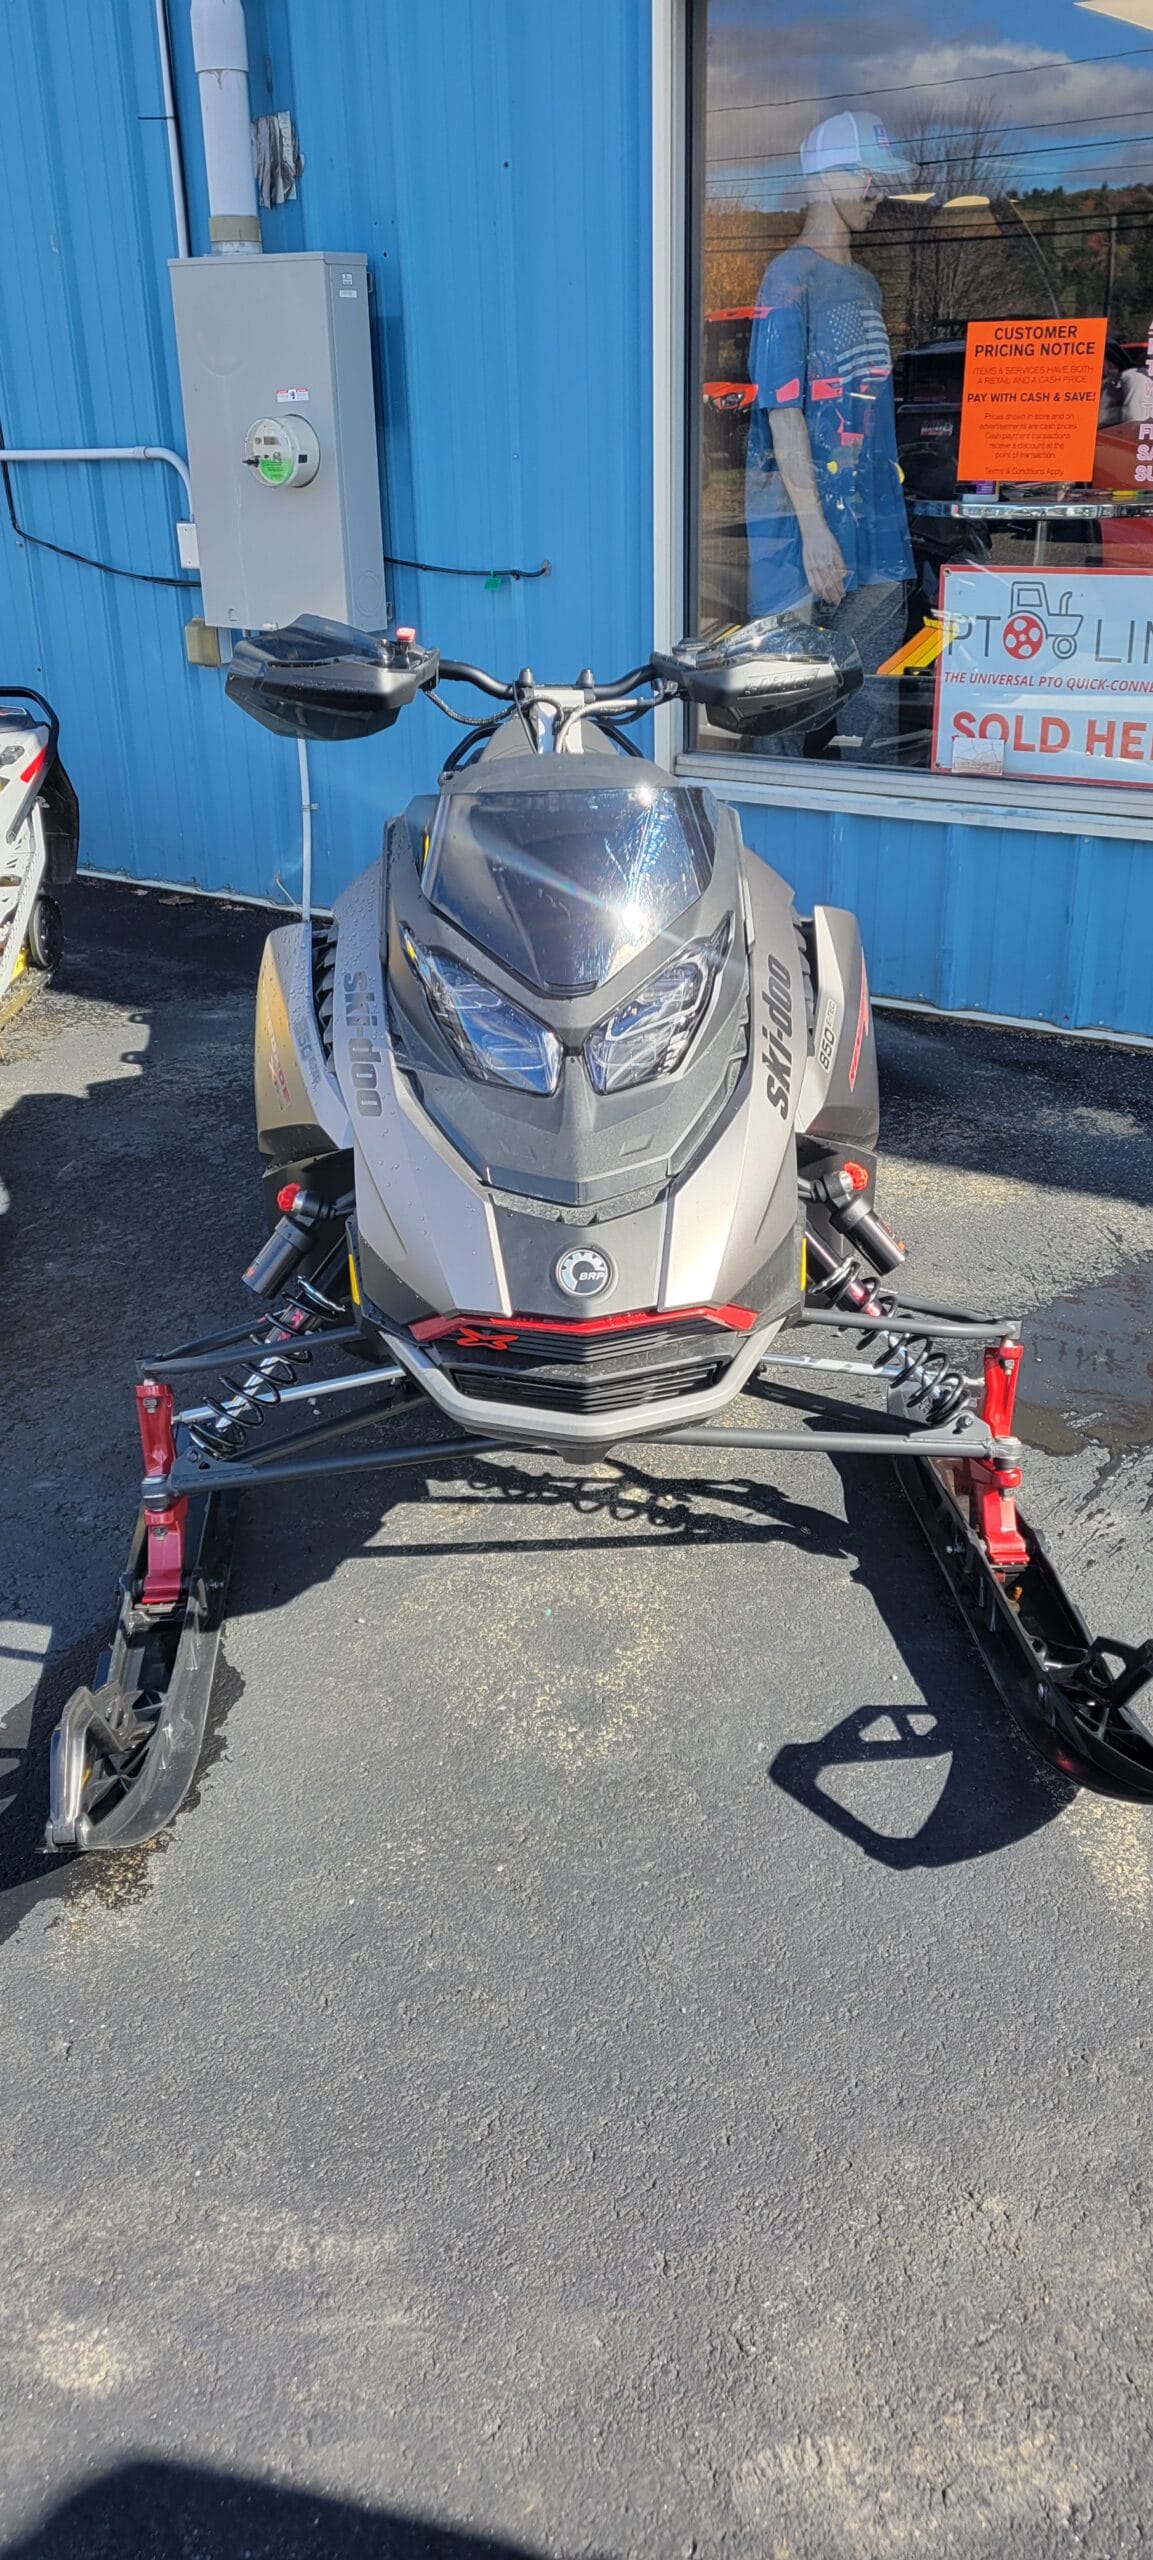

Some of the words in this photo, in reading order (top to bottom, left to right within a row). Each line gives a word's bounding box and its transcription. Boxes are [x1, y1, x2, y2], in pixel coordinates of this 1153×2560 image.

[994, 325, 1078, 340] CUSTOMER
[974, 343, 1035, 357] PRICING
[1040, 341, 1096, 355] NOTICE
[973, 367, 997, 376] ITEMS
[1005, 366, 1045, 375] SERVICES
[1047, 365, 1069, 374] HAVE
[1070, 364, 1094, 373] BOTH
[984, 376, 1010, 385] RETAIL
[1012, 376, 1030, 384] AND
[1038, 375, 1062, 384] CASH
[1062, 375, 1088, 384] PRICE
[967, 393, 988, 402] PAY
[990, 392, 1017, 402] WITH
[1020, 392, 1050, 402] CASH
[1053, 392, 1061, 401] &
[1064, 391, 1096, 401] SAVE!
[944, 671, 967, 683] THE
[969, 672, 1034, 687] UNIVERSAL
[1038, 675, 1063, 688] PTO
[952, 711, 1071, 753] SOLD
[1085, 719, 1153, 761] HE
[761, 954, 793, 1121] ski-doo
[819, 1027, 836, 1071] 850
[579, 1271, 605, 1281] BRP
